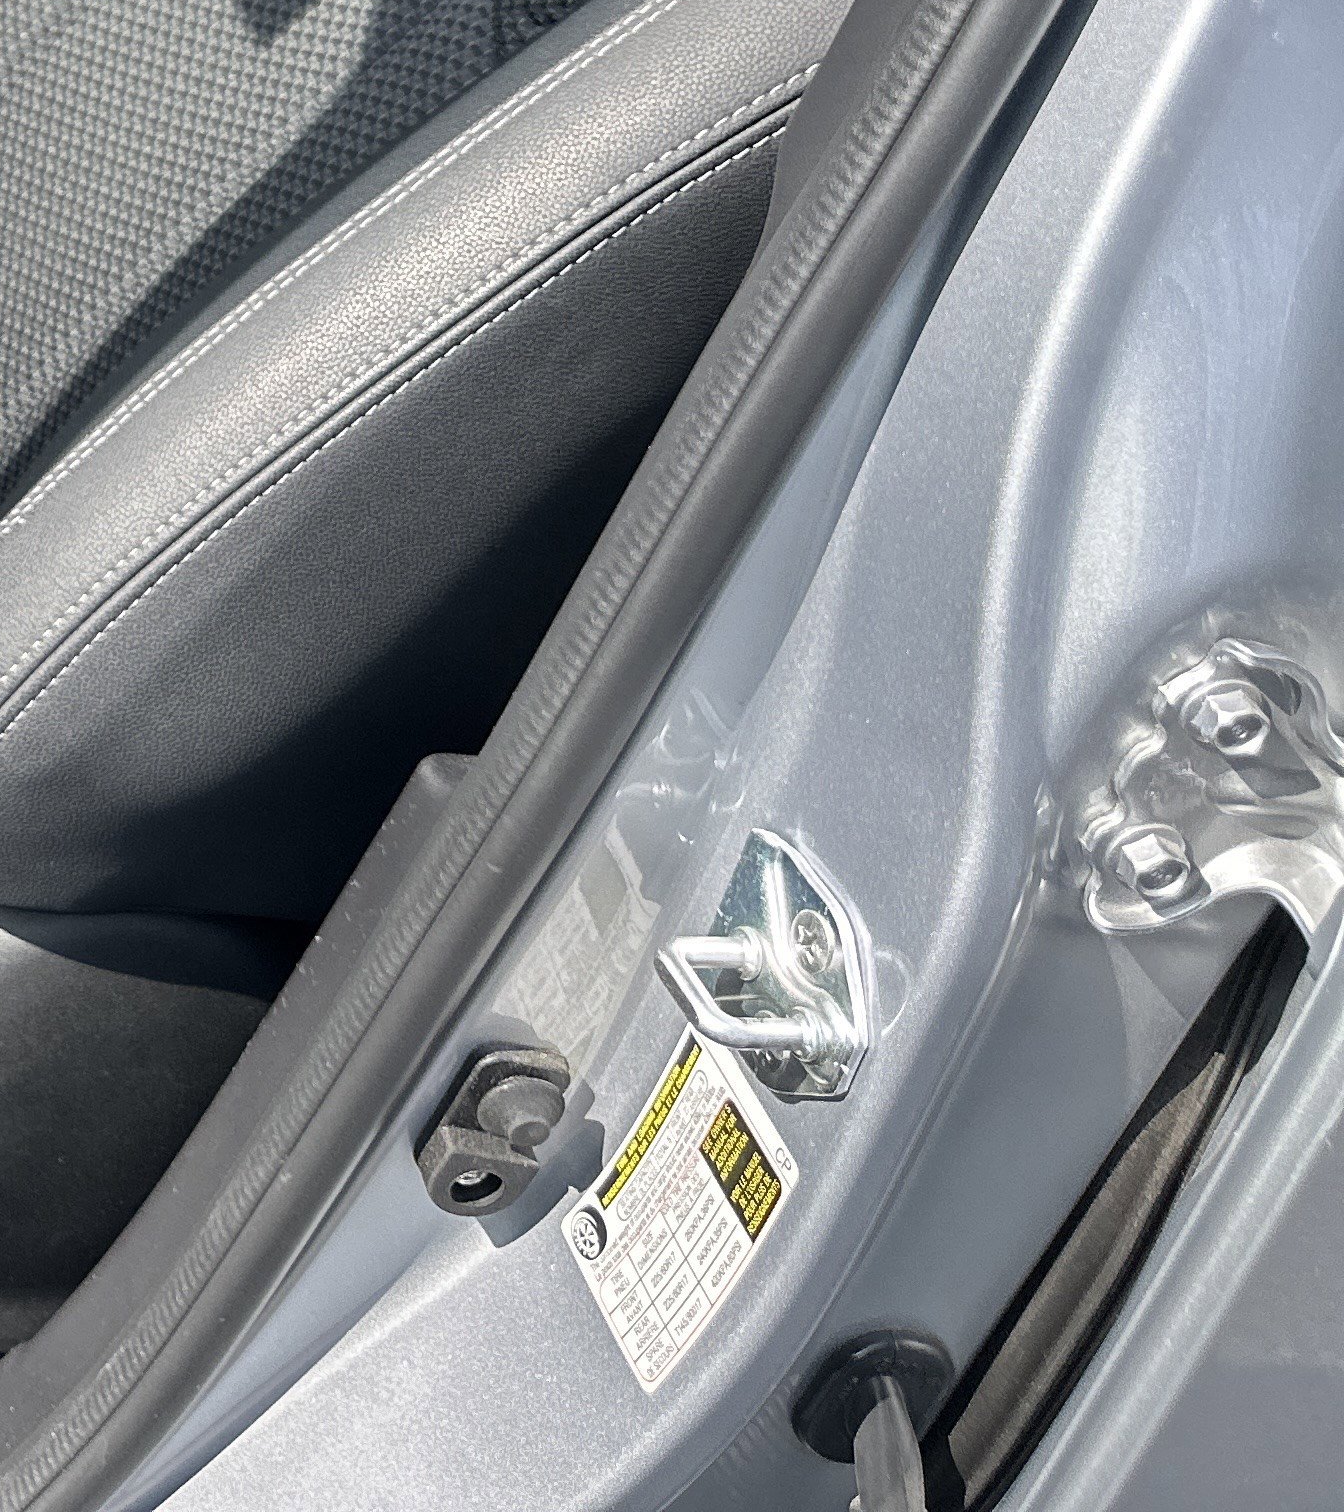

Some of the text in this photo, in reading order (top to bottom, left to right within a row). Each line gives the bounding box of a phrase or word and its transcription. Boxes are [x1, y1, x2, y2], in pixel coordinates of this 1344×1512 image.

[701, 1134, 713, 1154] SEE
[708, 1111, 737, 1162] MANUAL FOR
[714, 1125, 741, 1170] ADDITIONAL
[719, 1130, 749, 1182] INFORMATION
[738, 1174, 748, 1189] LE
[743, 1149, 761, 1179] MANUEL
[775, 1147, 793, 1172] CP
[742, 1197, 757, 1221] POUR
[762, 1171, 772, 1187] DE
[636, 1226, 668, 1271] DIMENSIONS
[619, 1288, 639, 1315] FRONT
[633, 1314, 650, 1336] REAR
